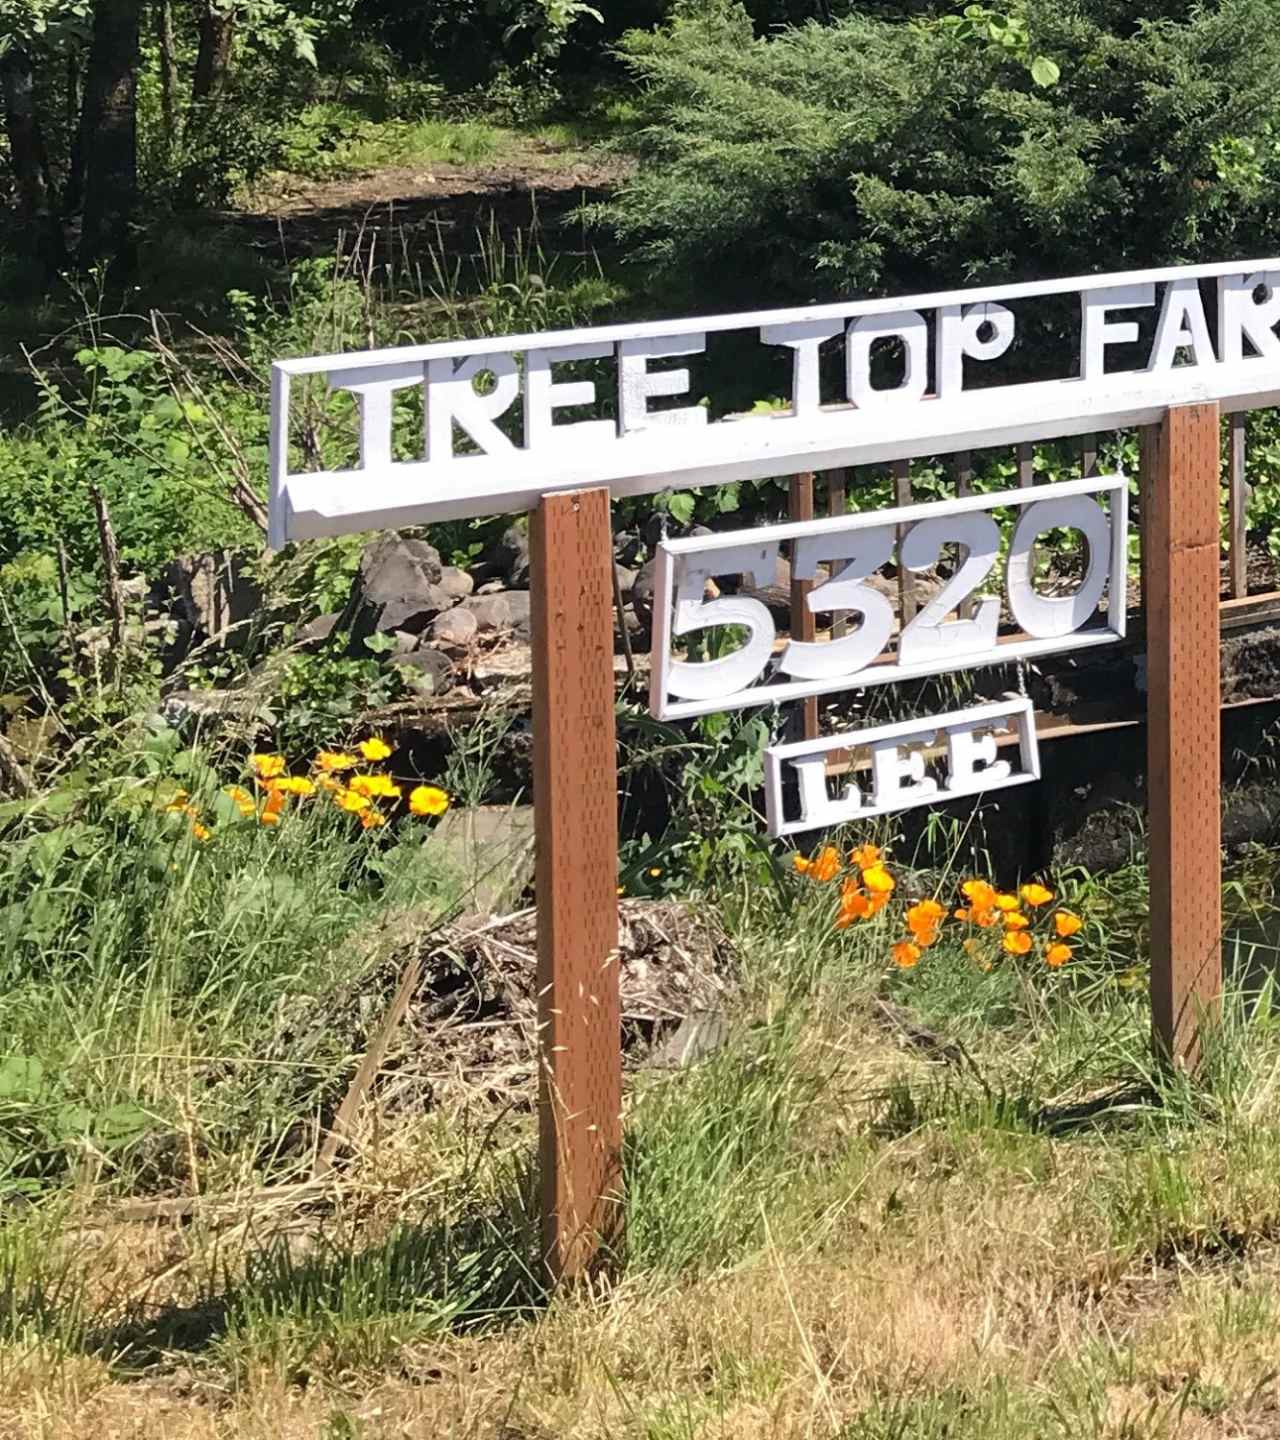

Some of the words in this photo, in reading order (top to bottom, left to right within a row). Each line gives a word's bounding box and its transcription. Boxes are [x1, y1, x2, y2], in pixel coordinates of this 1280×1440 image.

[328, 330, 706, 471] TREE
[760, 302, 1015, 417] TOP
[666, 494, 1111, 700] 5320
[790, 718, 1011, 823] LEE
